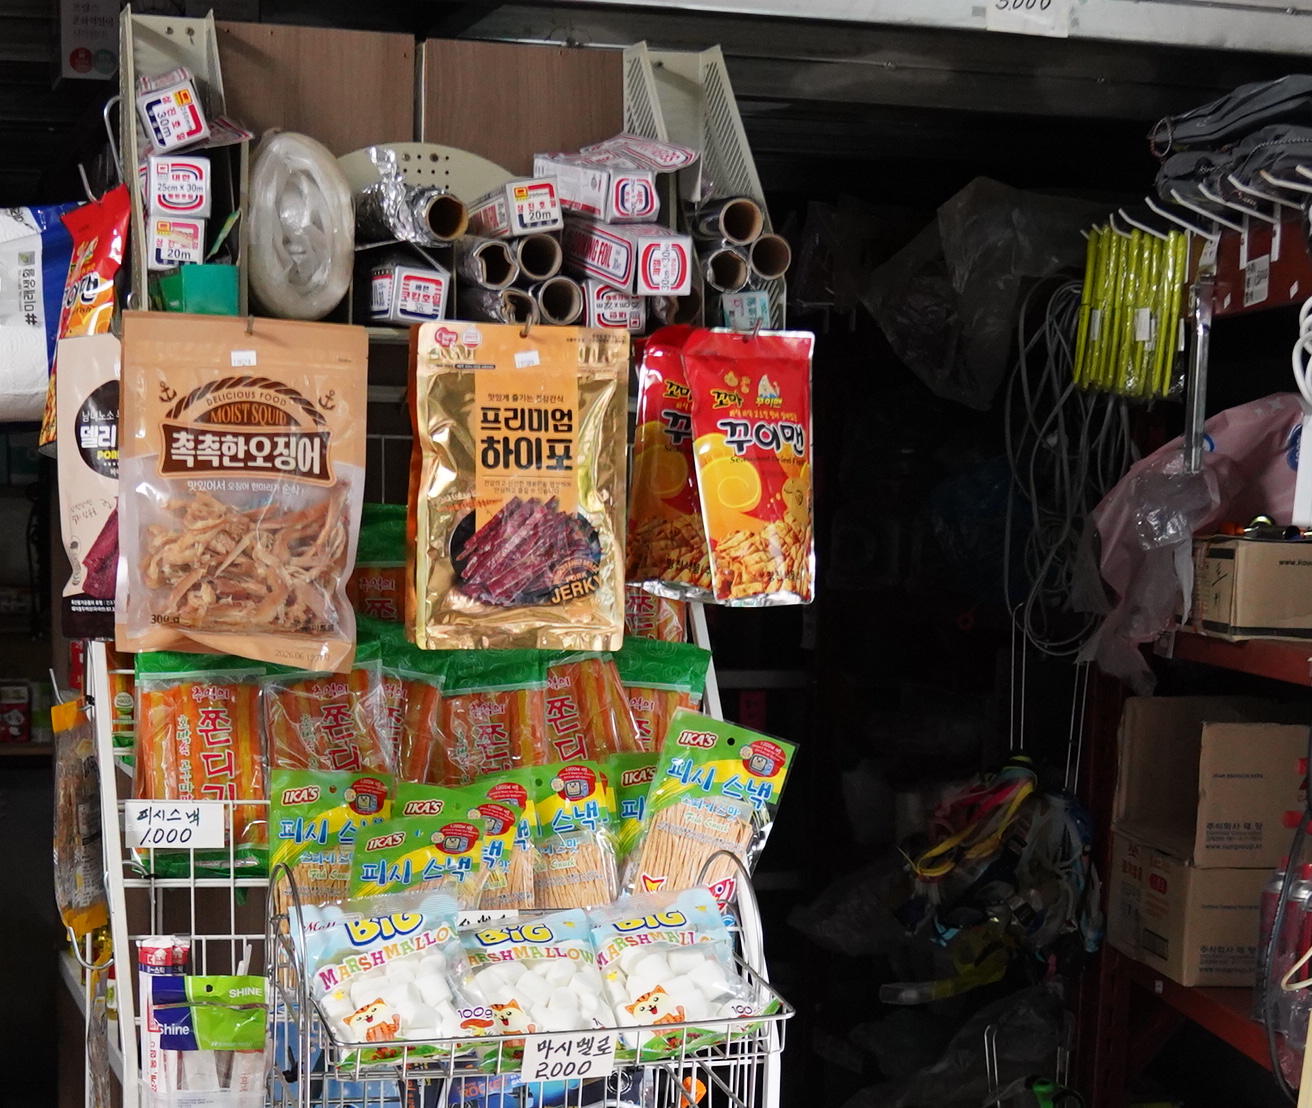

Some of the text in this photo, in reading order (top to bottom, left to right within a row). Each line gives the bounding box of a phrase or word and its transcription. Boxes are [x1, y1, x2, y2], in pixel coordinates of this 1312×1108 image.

[528, 210, 552, 221] 20m
[167, 249, 191, 260] 20m
[206, 391, 288, 407] DELICIOUS FOOD
[711, 389, 743, 410] 꼬마
[210, 405, 250, 424] MOIST
[480, 406, 574, 434] 프리미엄
[719, 419, 805, 458] 꾸이맨
[170, 430, 322, 476] 촉촉한오징어
[480, 435, 574, 472] 하이포
[187, 480, 226, 493] 맛있어서
[565, 571, 588, 584] PORK
[550, 574, 604, 605] JERKY
[191, 685, 231, 701] 추억의
[320, 702, 362, 772] 쫀디
[545, 695, 588, 763] 쫀디
[677, 730, 718, 750] IKA'S
[282, 785, 322, 805] IKA'S
[665, 756, 774, 812] 피시 스낵
[404, 799, 445, 816] IKA'S
[278, 818, 329, 845] 피시
[365, 831, 406, 852] IKA'S
[360, 857, 473, 886] 피시 스낵
[344, 908, 425, 948] BIG
[612, 907, 689, 936] BIG
[476, 922, 555, 947] BIG
[229, 986, 263, 999] SHINE
[156, 1022, 190, 1037] Shine
[536, 1034, 613, 1060] 마시멜로
